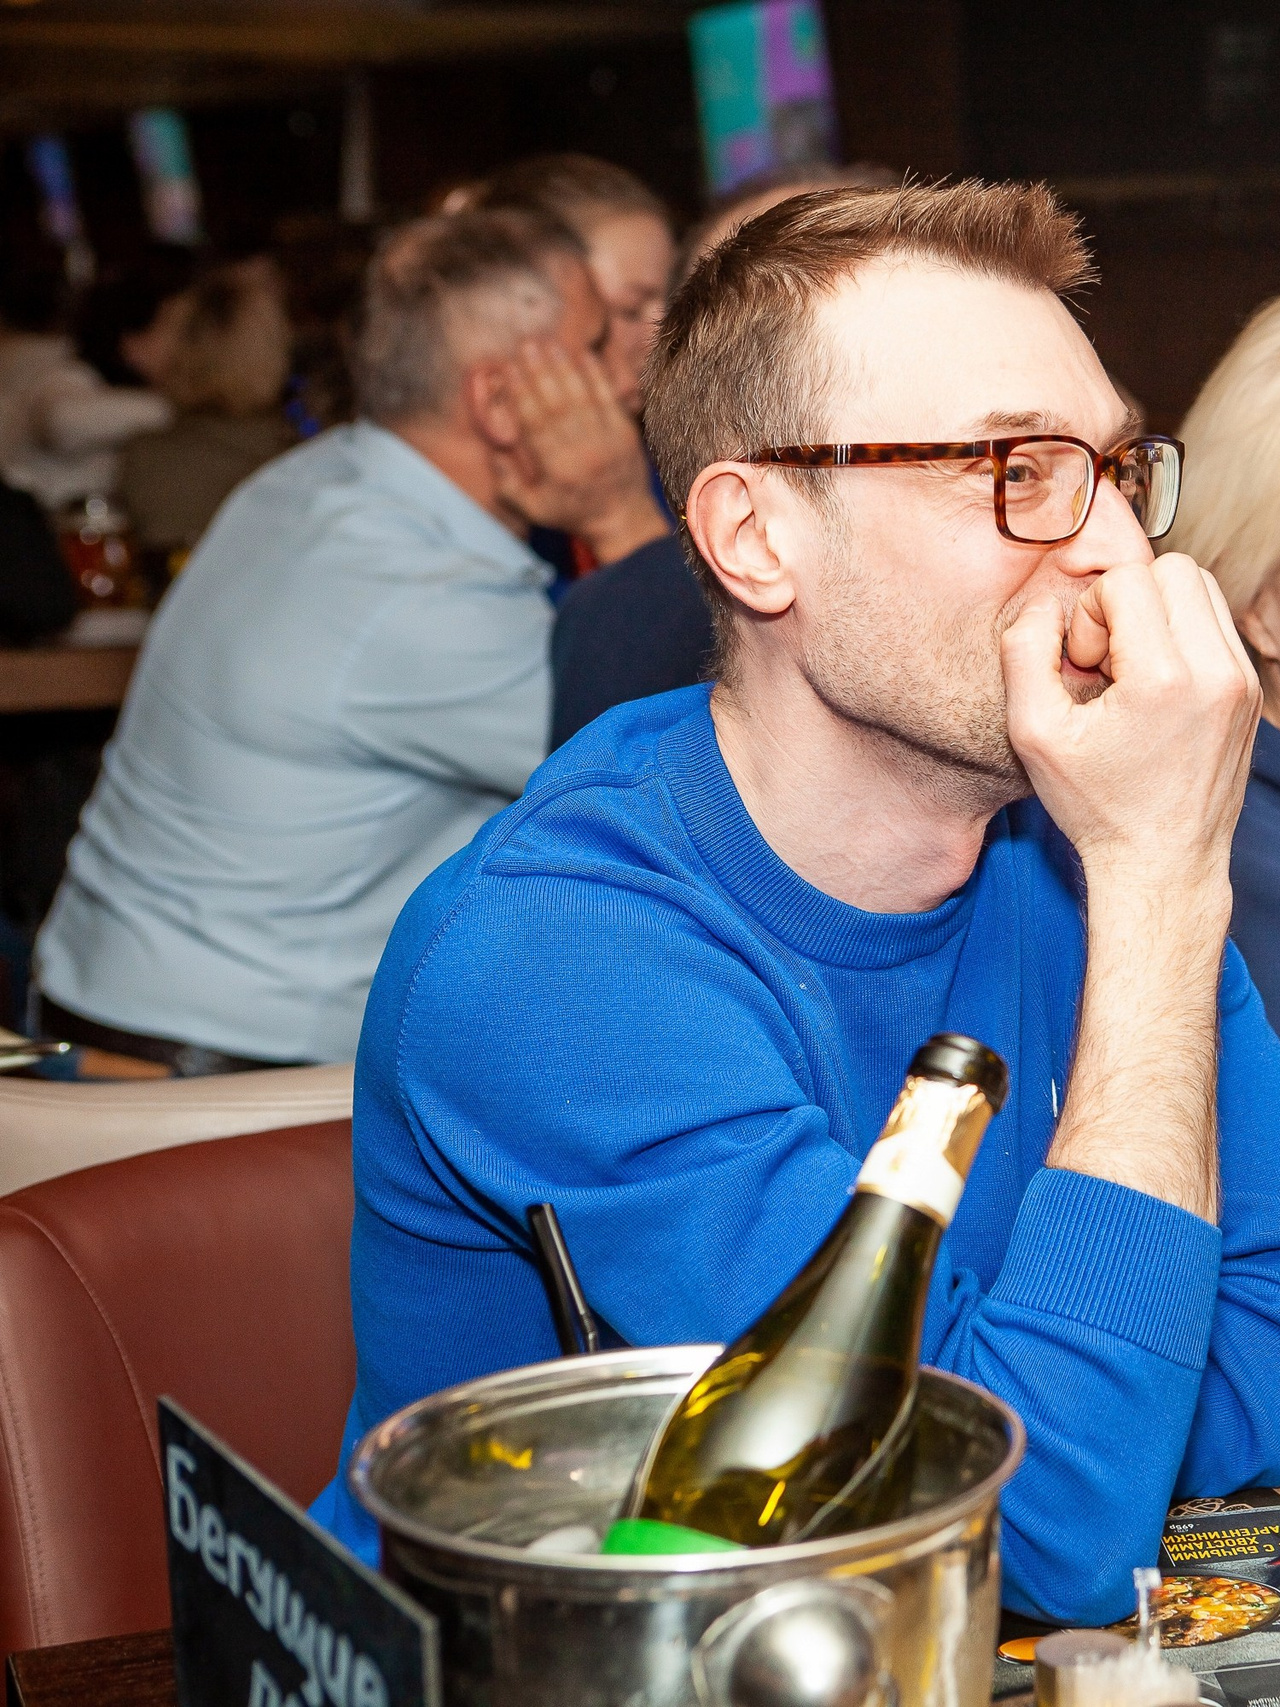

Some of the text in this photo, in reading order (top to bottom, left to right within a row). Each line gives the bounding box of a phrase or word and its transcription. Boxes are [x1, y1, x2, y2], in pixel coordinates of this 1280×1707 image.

[1166, 1536, 1257, 1552] ХВОСТАМИ
[1263, 1543, 1275, 1552] С
[1171, 1546, 1258, 1561] БЫЧЬИМИ
